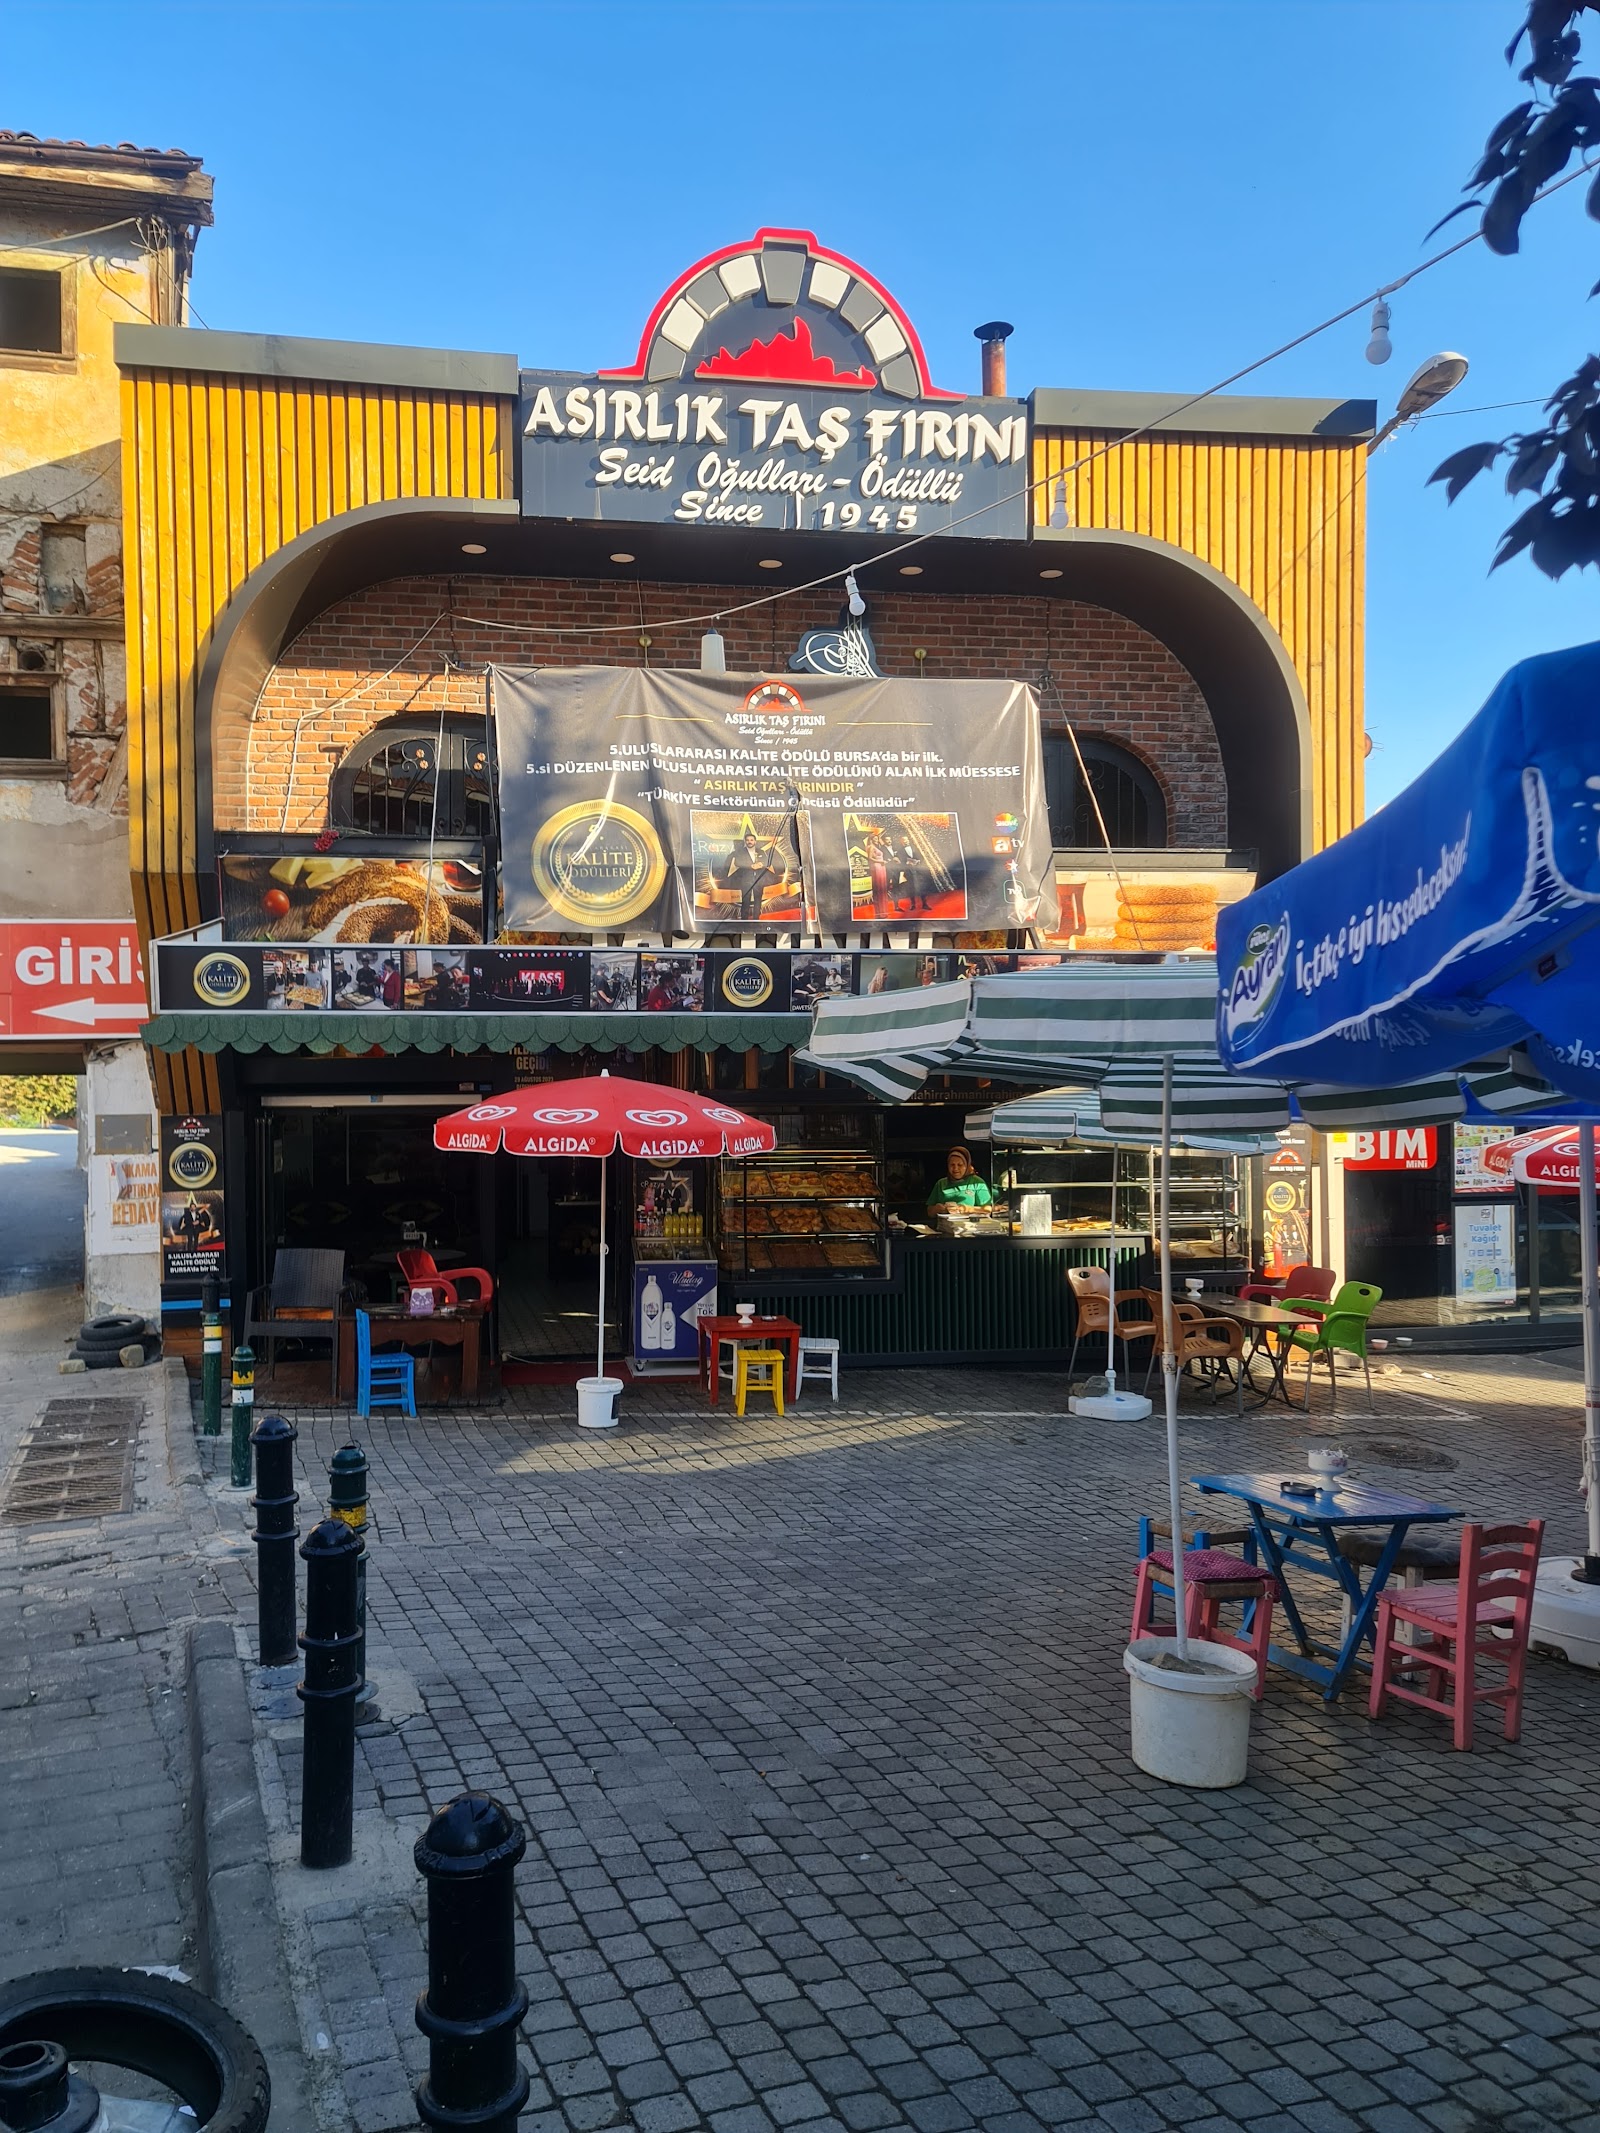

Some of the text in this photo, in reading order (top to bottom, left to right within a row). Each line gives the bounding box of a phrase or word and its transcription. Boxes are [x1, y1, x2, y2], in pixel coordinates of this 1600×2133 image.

[524, 386, 1027, 465] ASIRLIK TAŞ FIRINI
[595, 447, 675, 488] Seid
[697, 451, 827, 503] Oğulları
[860, 453, 964, 500] Ödüllü
[674, 490, 763, 522] Since
[820, 501, 918, 531] 1945
[724, 713, 826, 727] ASIRLIK TAŞ FIRINI
[609, 742, 726, 760] 5.ULUSLARARASI
[730, 748, 778, 761] KALİTE
[781, 749, 830, 762] ÖDÜLÜ
[901, 750, 920, 762] bir
[922, 751, 944, 763] ilk.
[526, 758, 1021, 778] 5.si DÜZENLENEN ULUSLARARASI KALİTE ÖDÜLÜNÜ ALAN İLK MÜESSESE
[704, 780, 758, 792] ASIRLIK
[760, 781, 787, 794] TAŞ
[703, 795, 785, 808] Sektörünün
[1348, 905, 1374, 965] iyi
[1469, 1224, 1502, 1232] Tuvalet
[1471, 1233, 1500, 1244] Kağıdı
